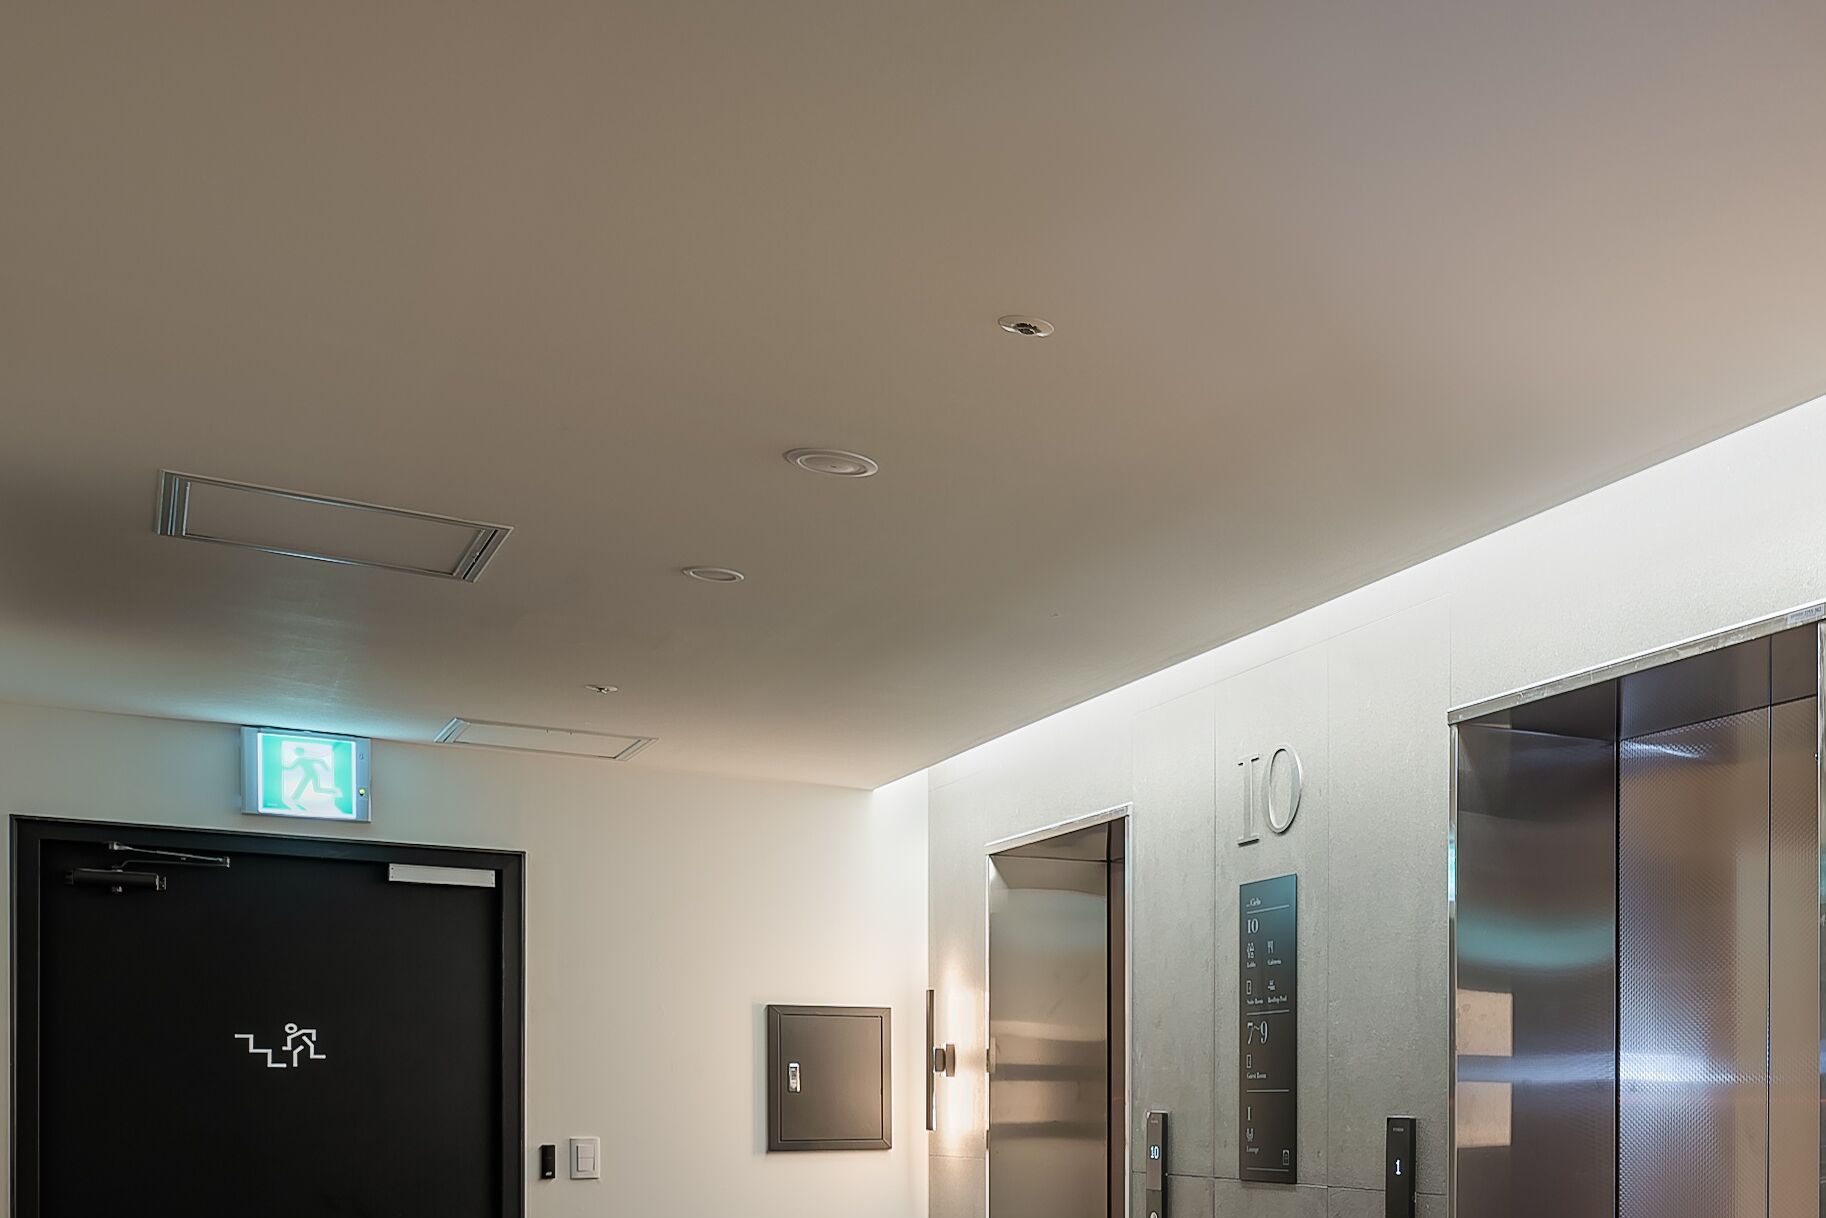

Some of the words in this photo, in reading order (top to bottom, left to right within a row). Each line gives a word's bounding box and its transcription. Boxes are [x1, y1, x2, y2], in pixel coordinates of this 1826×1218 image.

[1236, 743, 1303, 848] 10
[1247, 918, 1259, 934] 10
[1150, 1145, 1159, 1159] 10
[1395, 1159, 1402, 1175] 1
